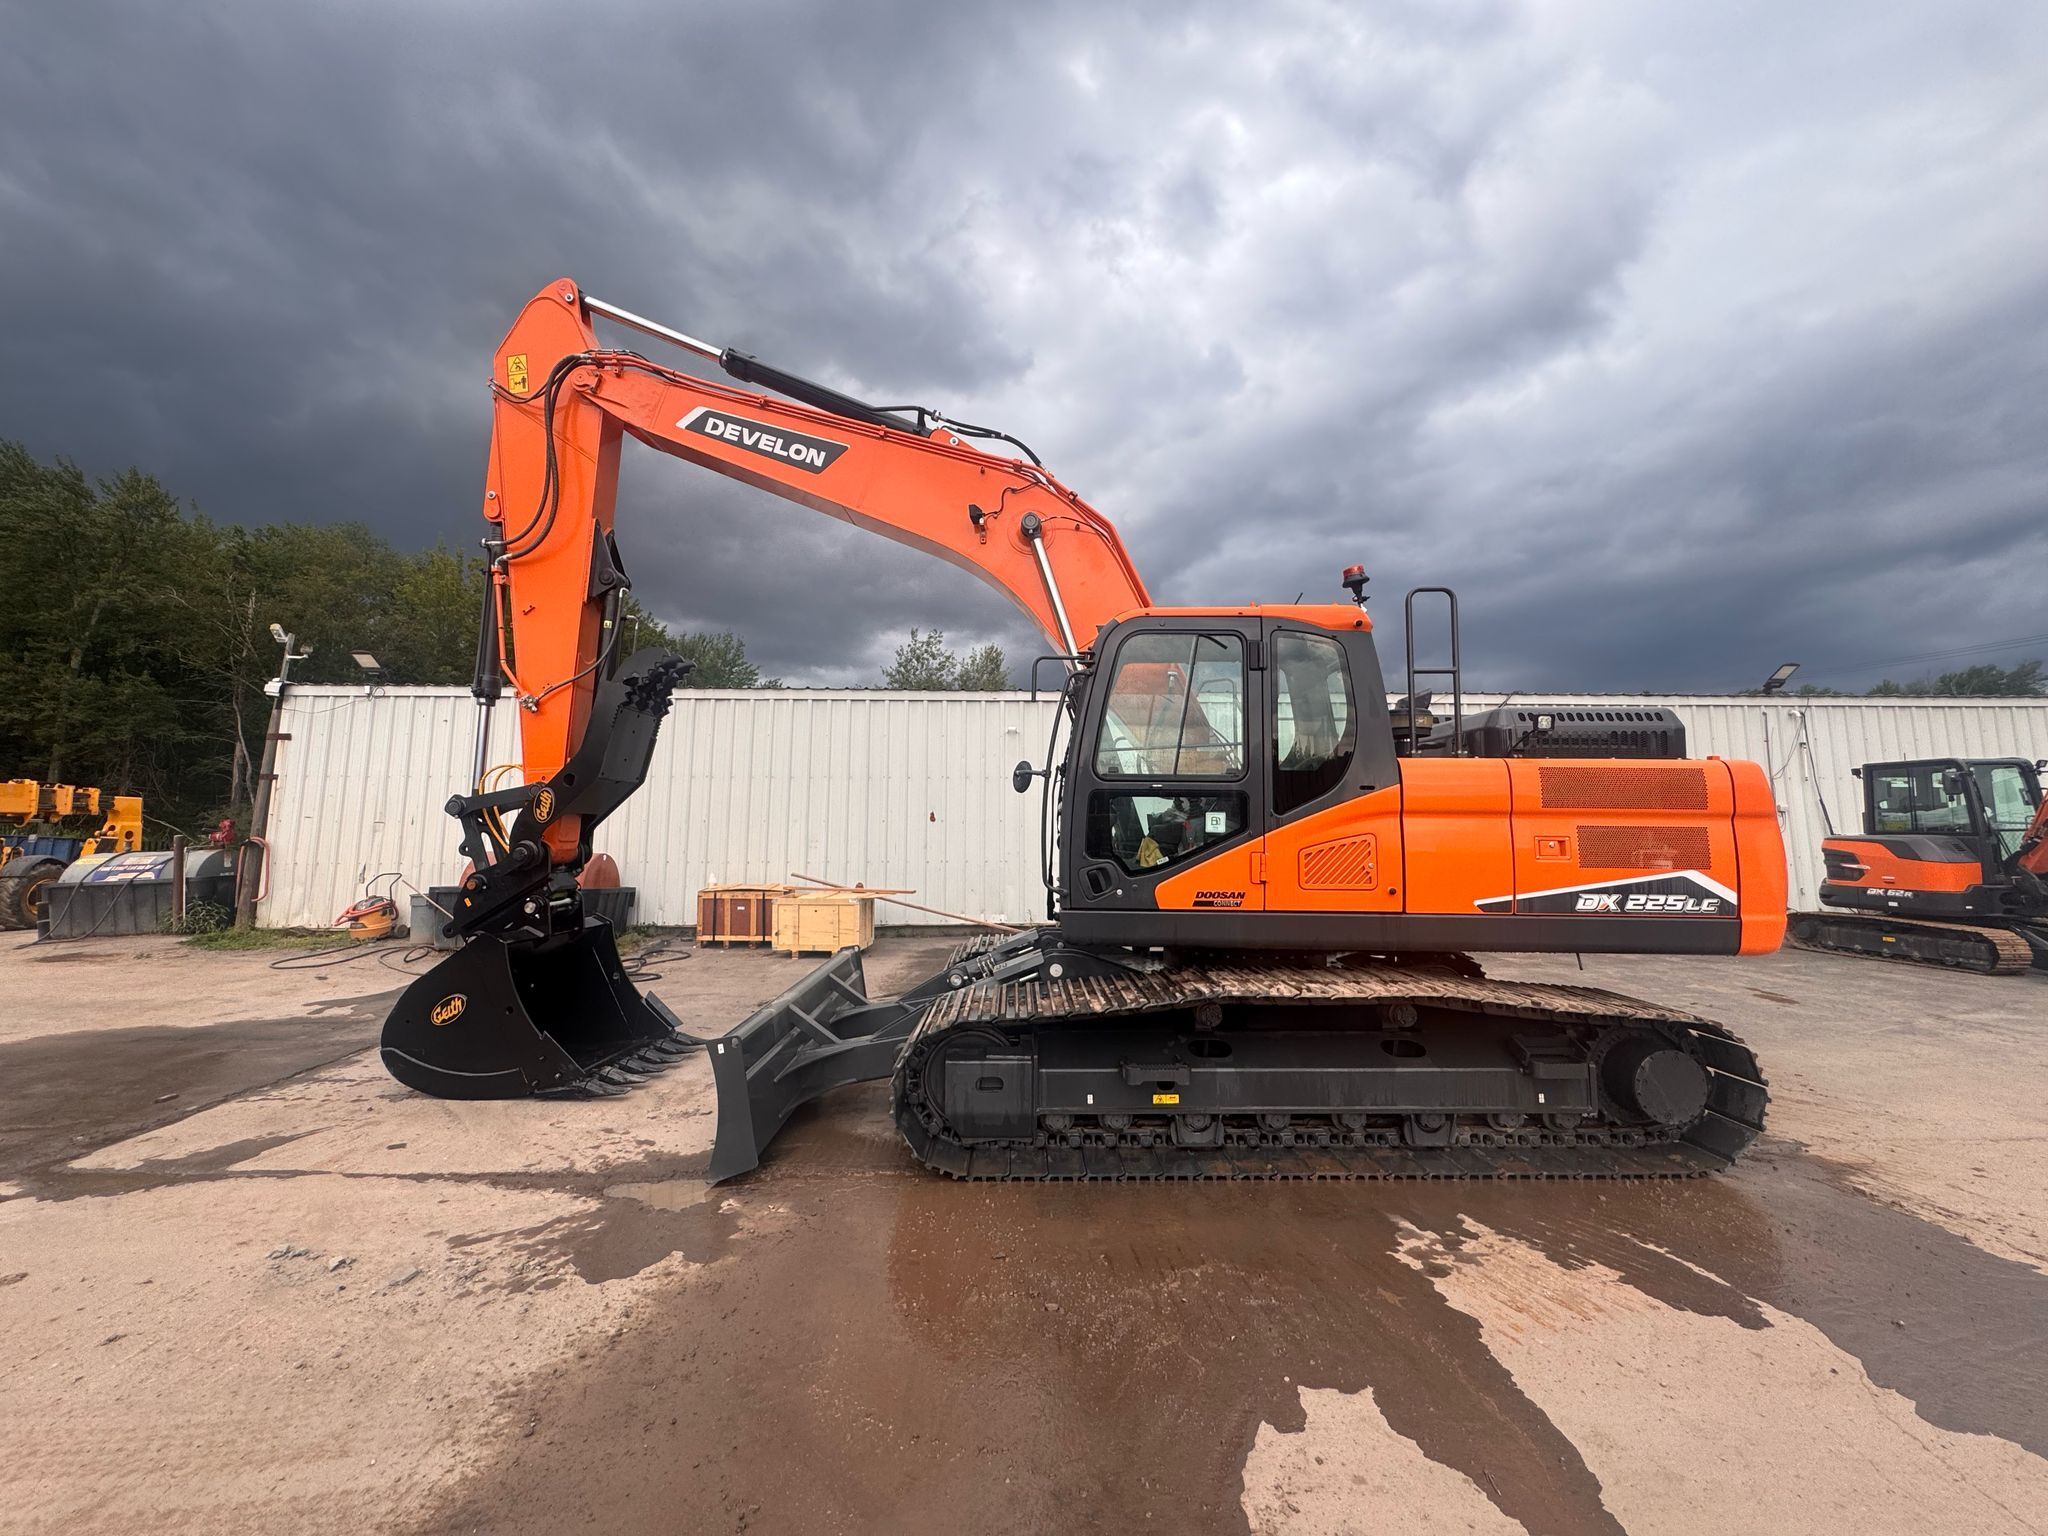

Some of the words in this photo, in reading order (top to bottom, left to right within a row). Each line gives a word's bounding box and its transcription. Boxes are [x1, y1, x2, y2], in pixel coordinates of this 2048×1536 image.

[704, 417, 826, 467] DEVELON
[1195, 891, 1246, 899] DOOSAN
[1575, 893, 1622, 912] DX
